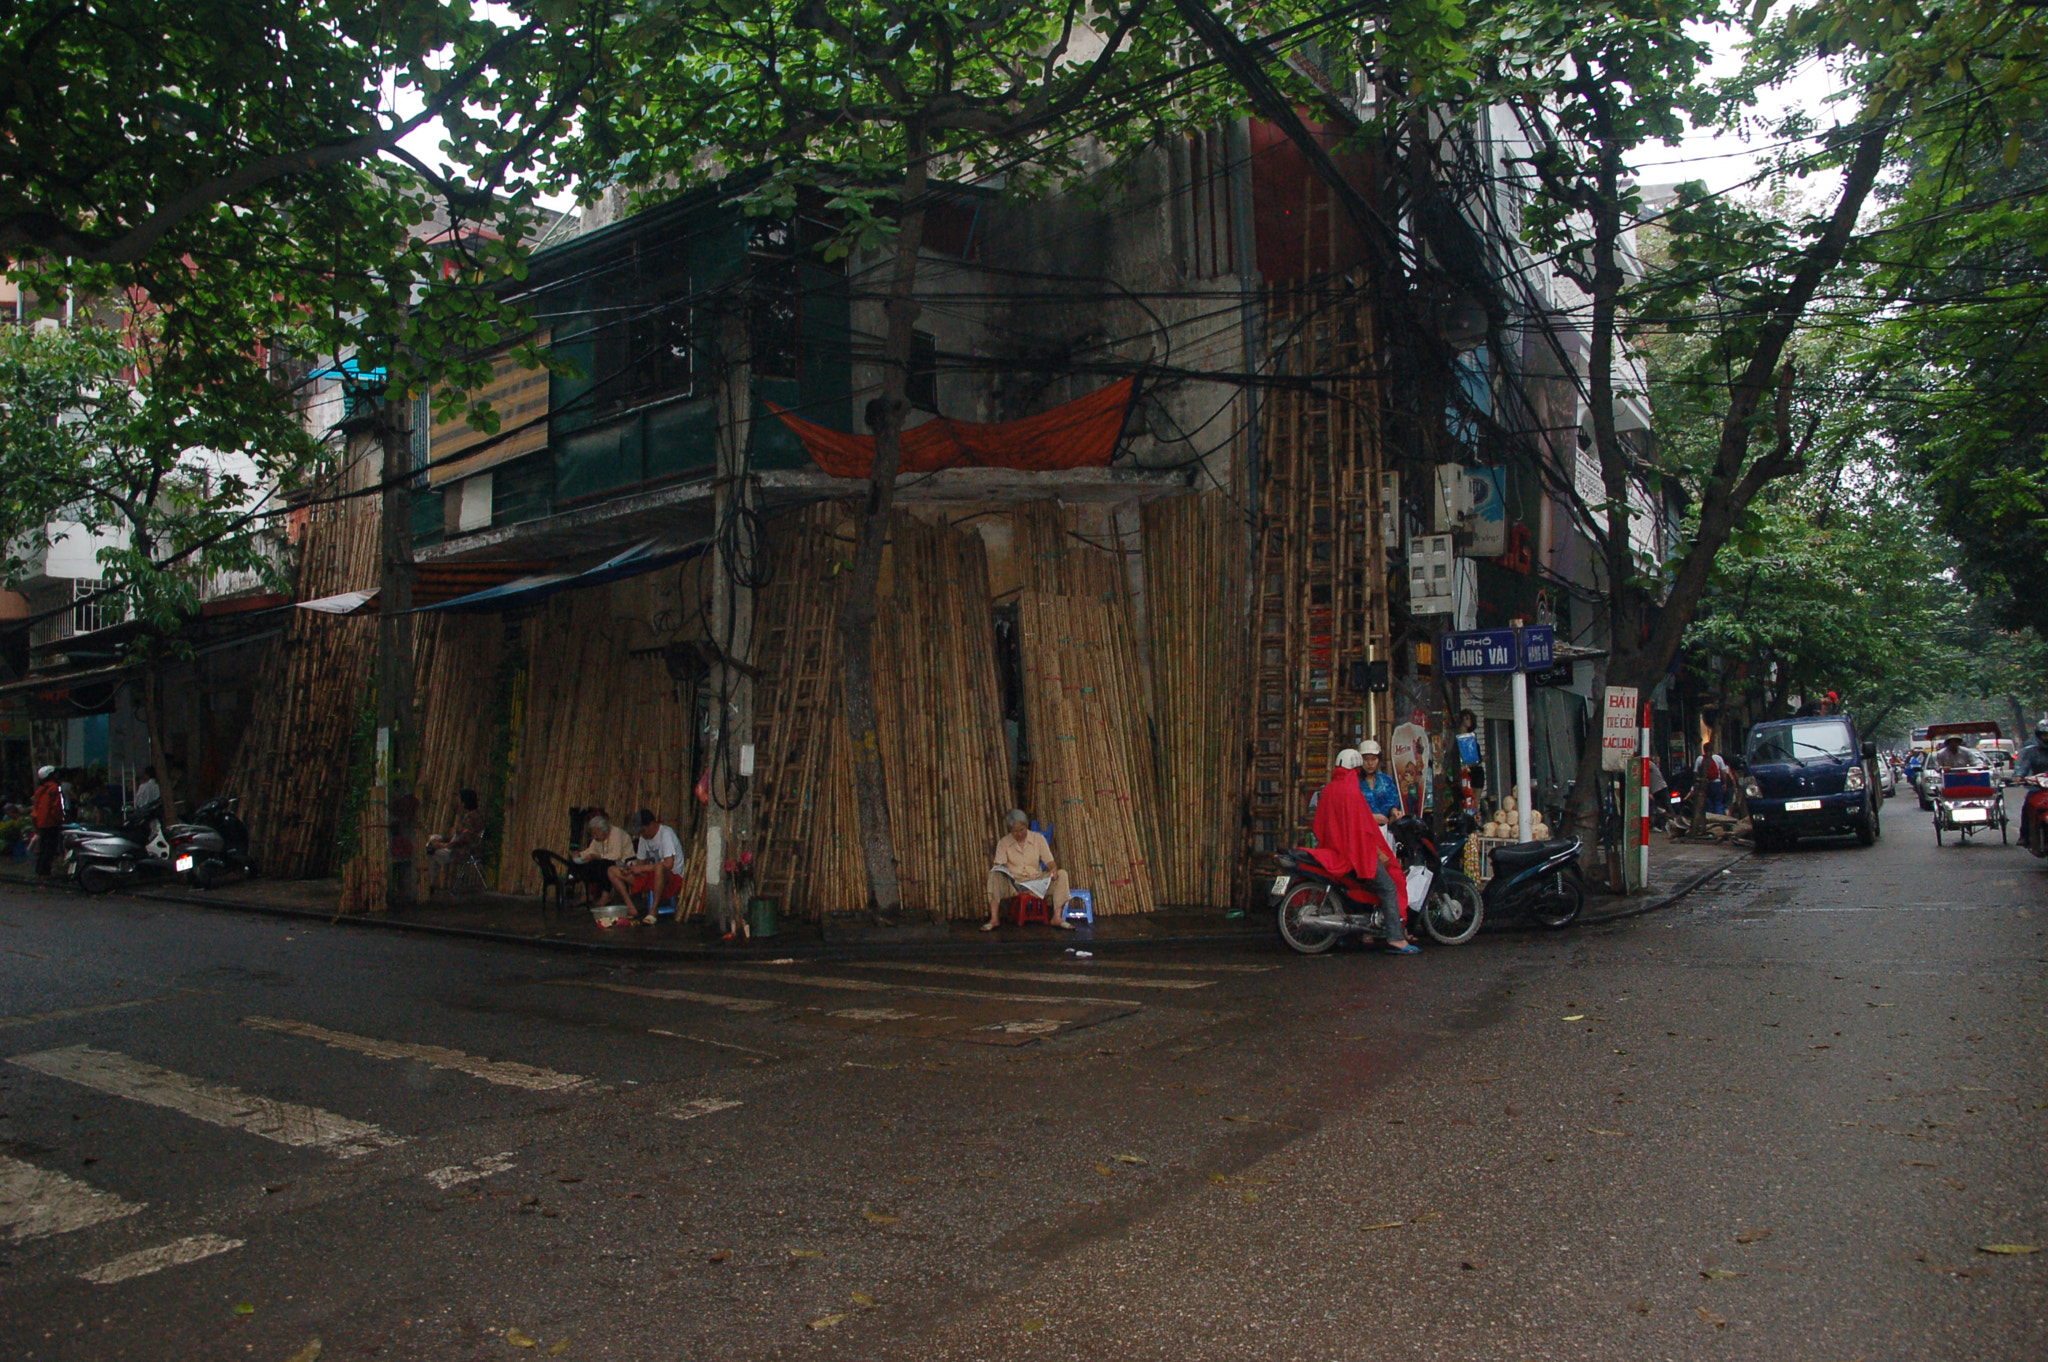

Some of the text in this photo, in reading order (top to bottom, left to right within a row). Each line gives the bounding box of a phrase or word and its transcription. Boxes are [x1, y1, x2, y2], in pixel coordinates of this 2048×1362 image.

[1464, 636, 1492, 646] PHỐ
[1452, 648, 1483, 667] HÀNG
[1609, 692, 1636, 709] BÁN
